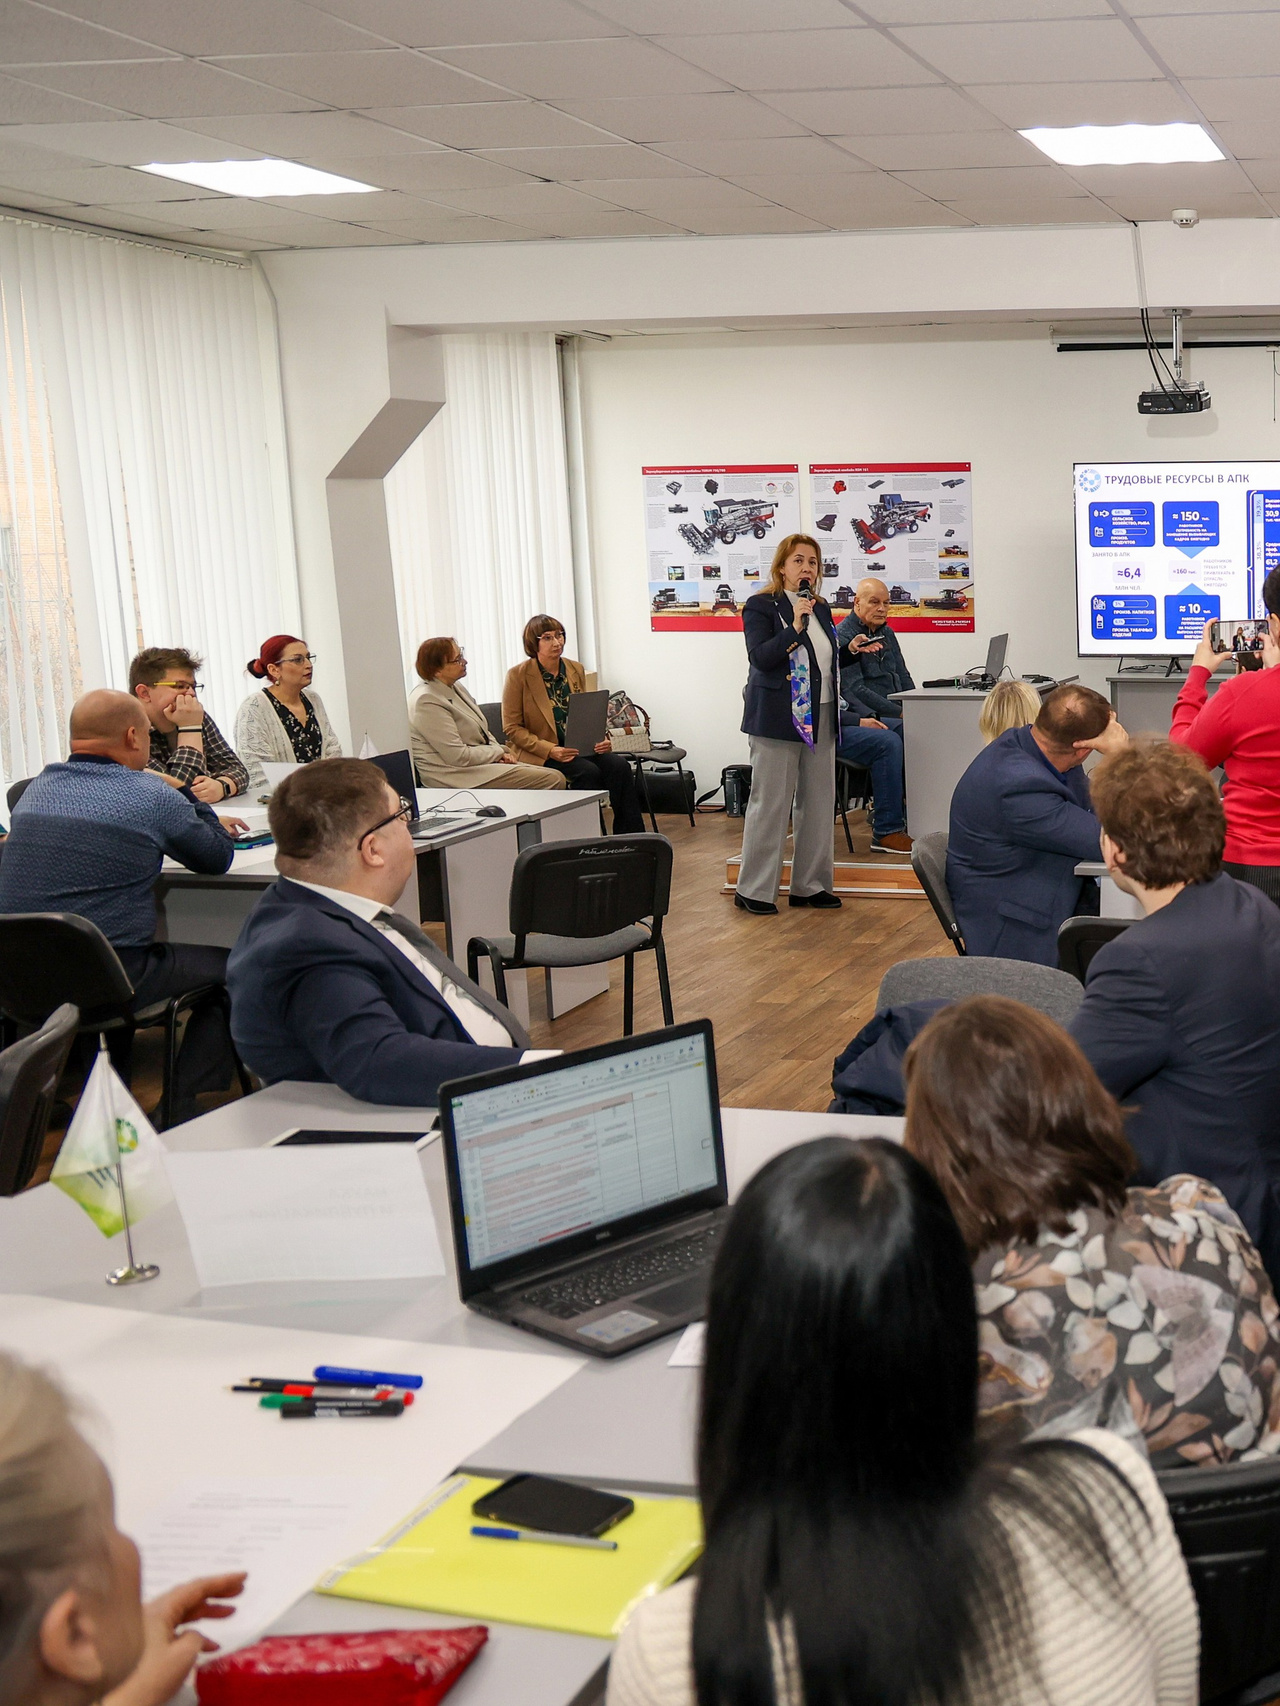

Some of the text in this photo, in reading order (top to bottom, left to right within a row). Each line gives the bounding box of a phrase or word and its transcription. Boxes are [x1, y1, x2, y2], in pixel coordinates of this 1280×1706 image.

[1105, 474, 1250, 486] ТРУДОВЫЕ РЕСУРСЫ В АПК
[1180, 511, 1200, 521] 150
[1188, 604, 1201, 614] 10
